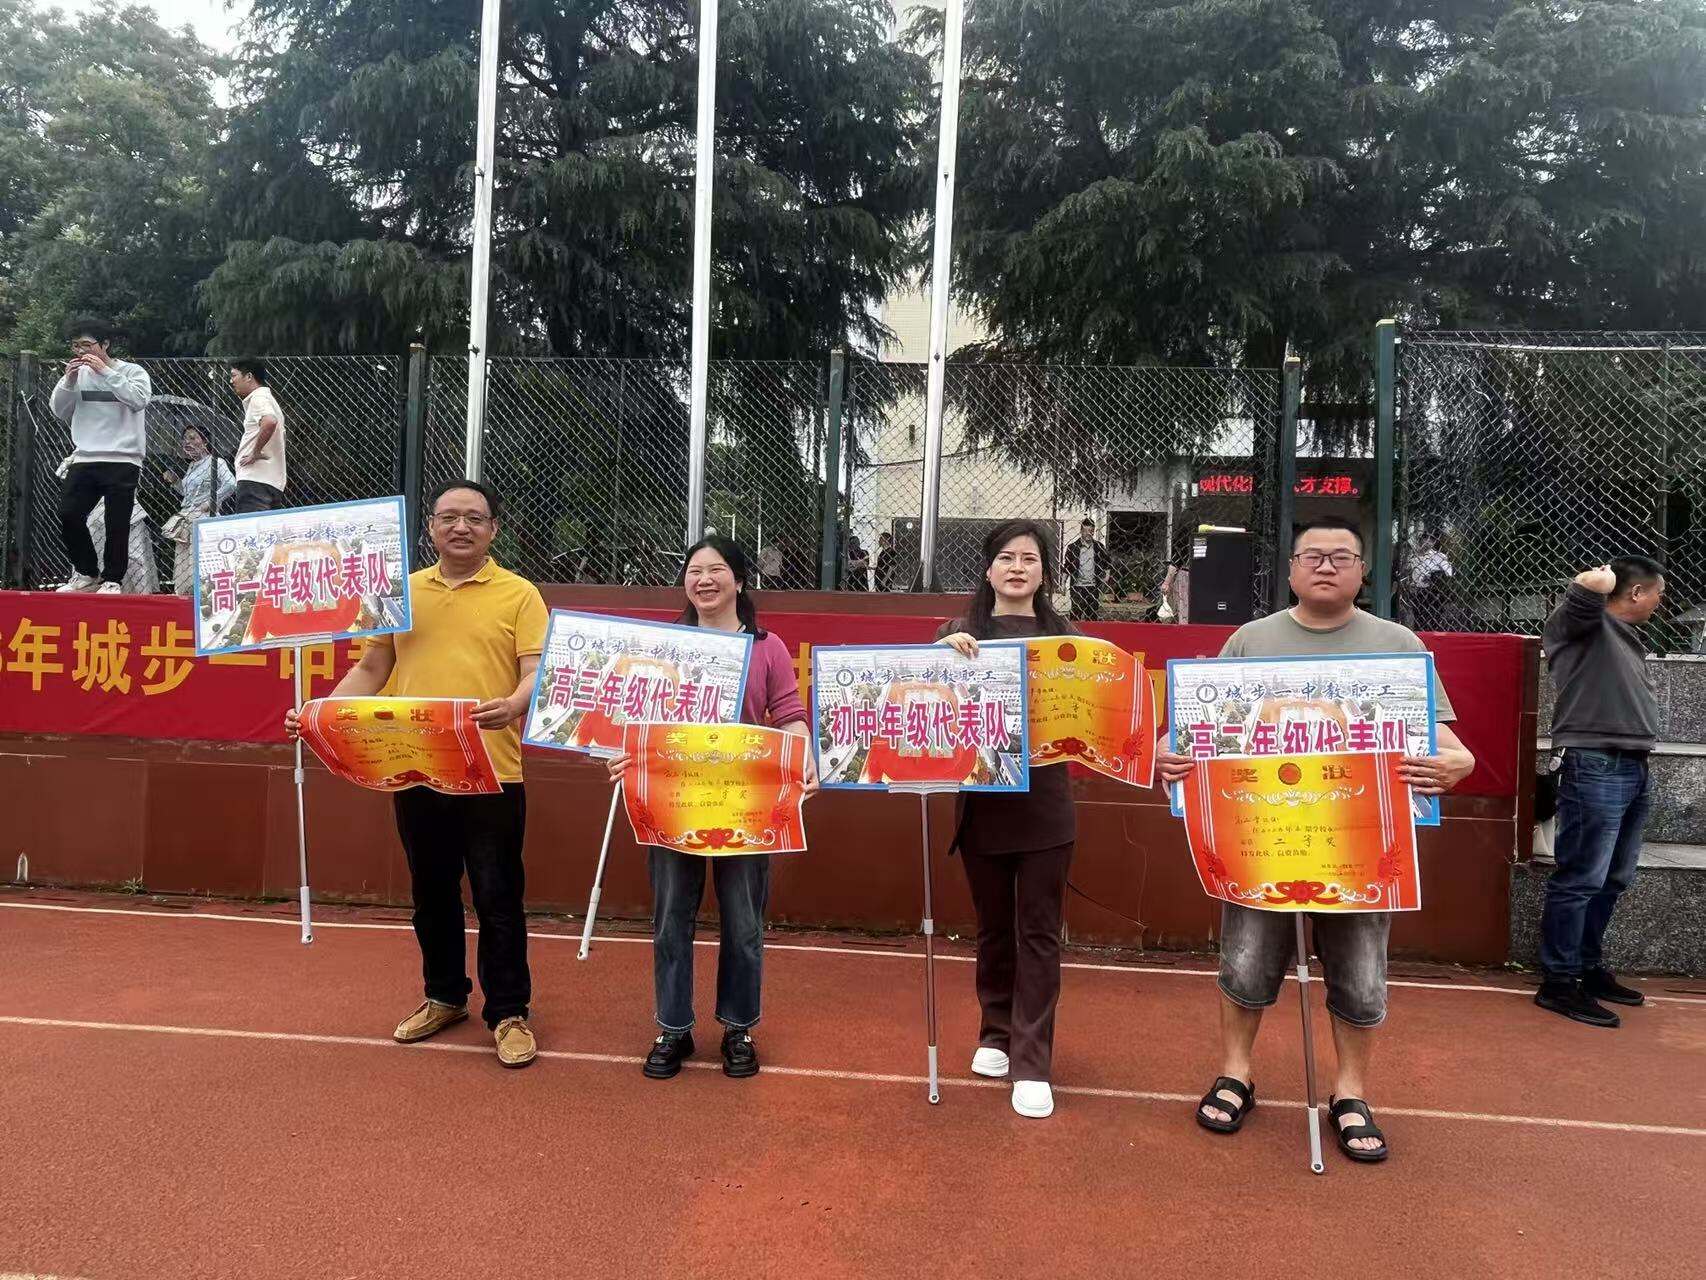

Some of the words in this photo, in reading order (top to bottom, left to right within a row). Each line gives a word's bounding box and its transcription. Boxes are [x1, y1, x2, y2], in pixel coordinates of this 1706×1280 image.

[1199, 474, 1253, 493] 现代化
[1294, 475, 1358, 495] 才支撑。
[210, 553, 392, 613] 高一年级代表队
[860, 667, 998, 686] 城步一中教职工
[1225, 682, 1397, 701] 城步一中教职工
[550, 666, 722, 724] 高三年级代表队
[830, 699, 1012, 750] 初中年级代表队
